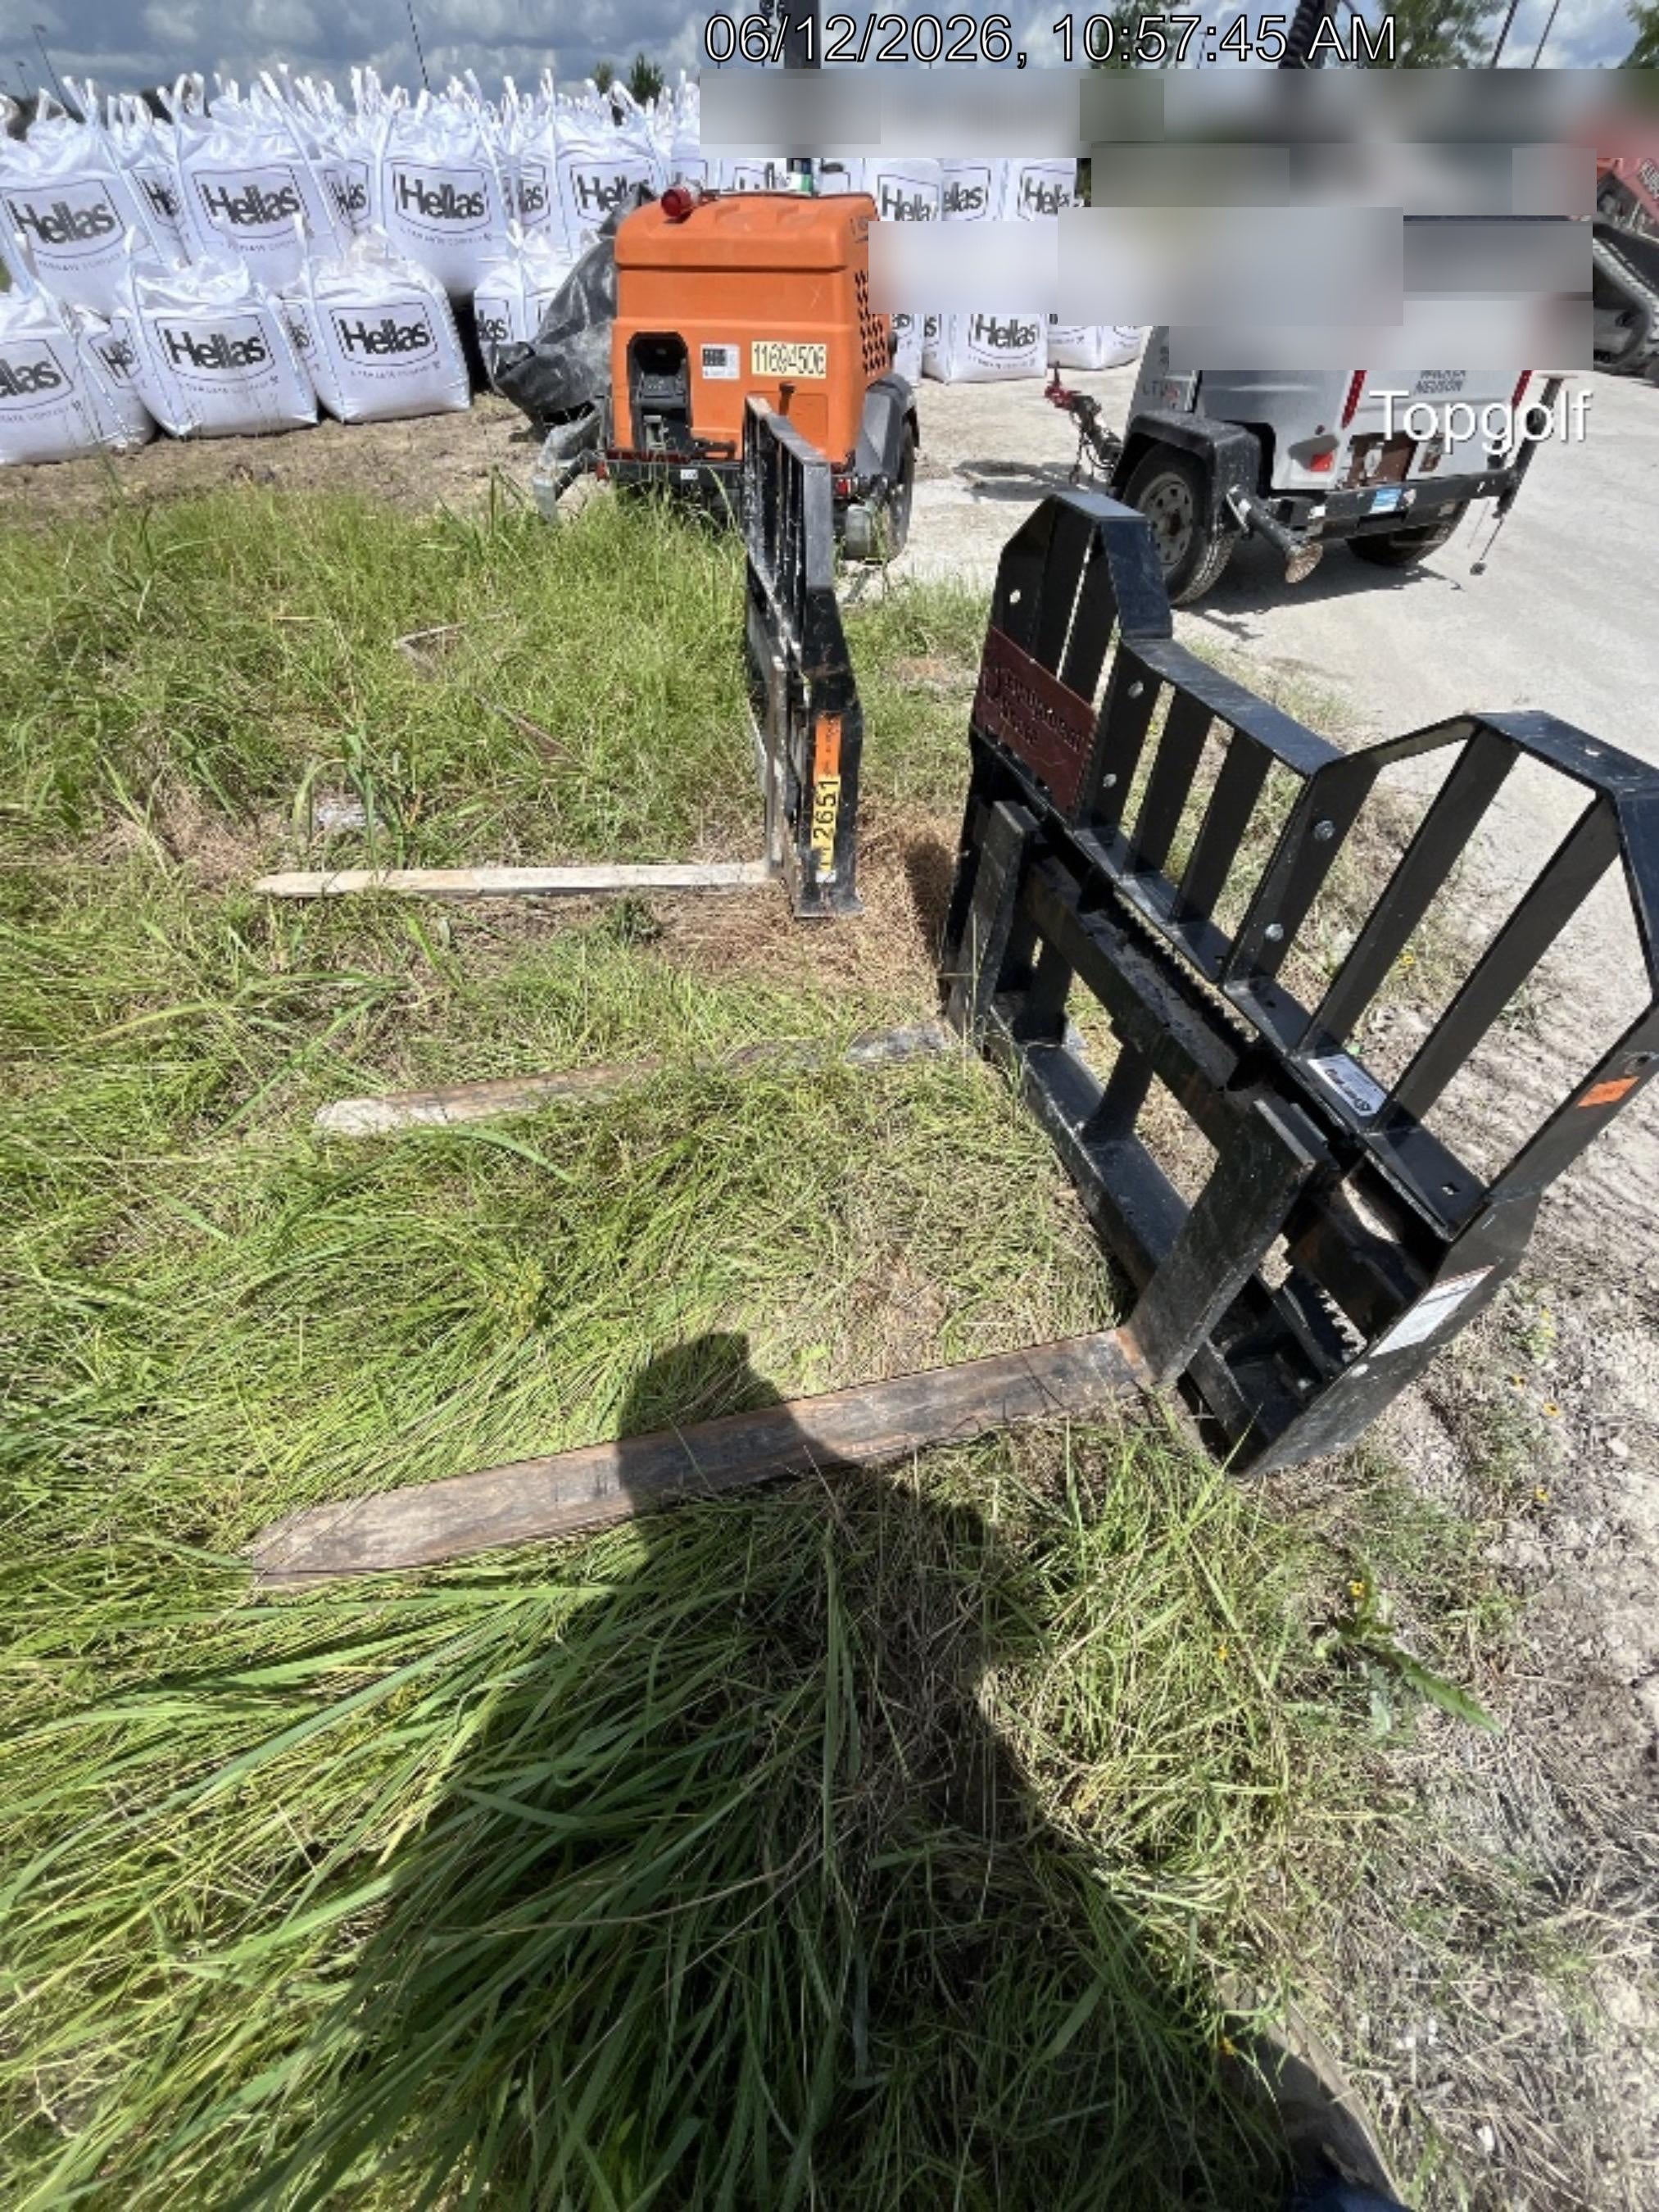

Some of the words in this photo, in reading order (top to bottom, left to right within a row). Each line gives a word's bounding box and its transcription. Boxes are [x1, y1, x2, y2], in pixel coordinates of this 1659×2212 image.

[202, 184, 300, 226] Hellas
[400, 174, 484, 219] Hellas
[7, 199, 116, 243] Hellas
[165, 329, 265, 369] Hellas
[339, 319, 429, 354] Hellas
[974, 314, 1036, 347] Hellas
